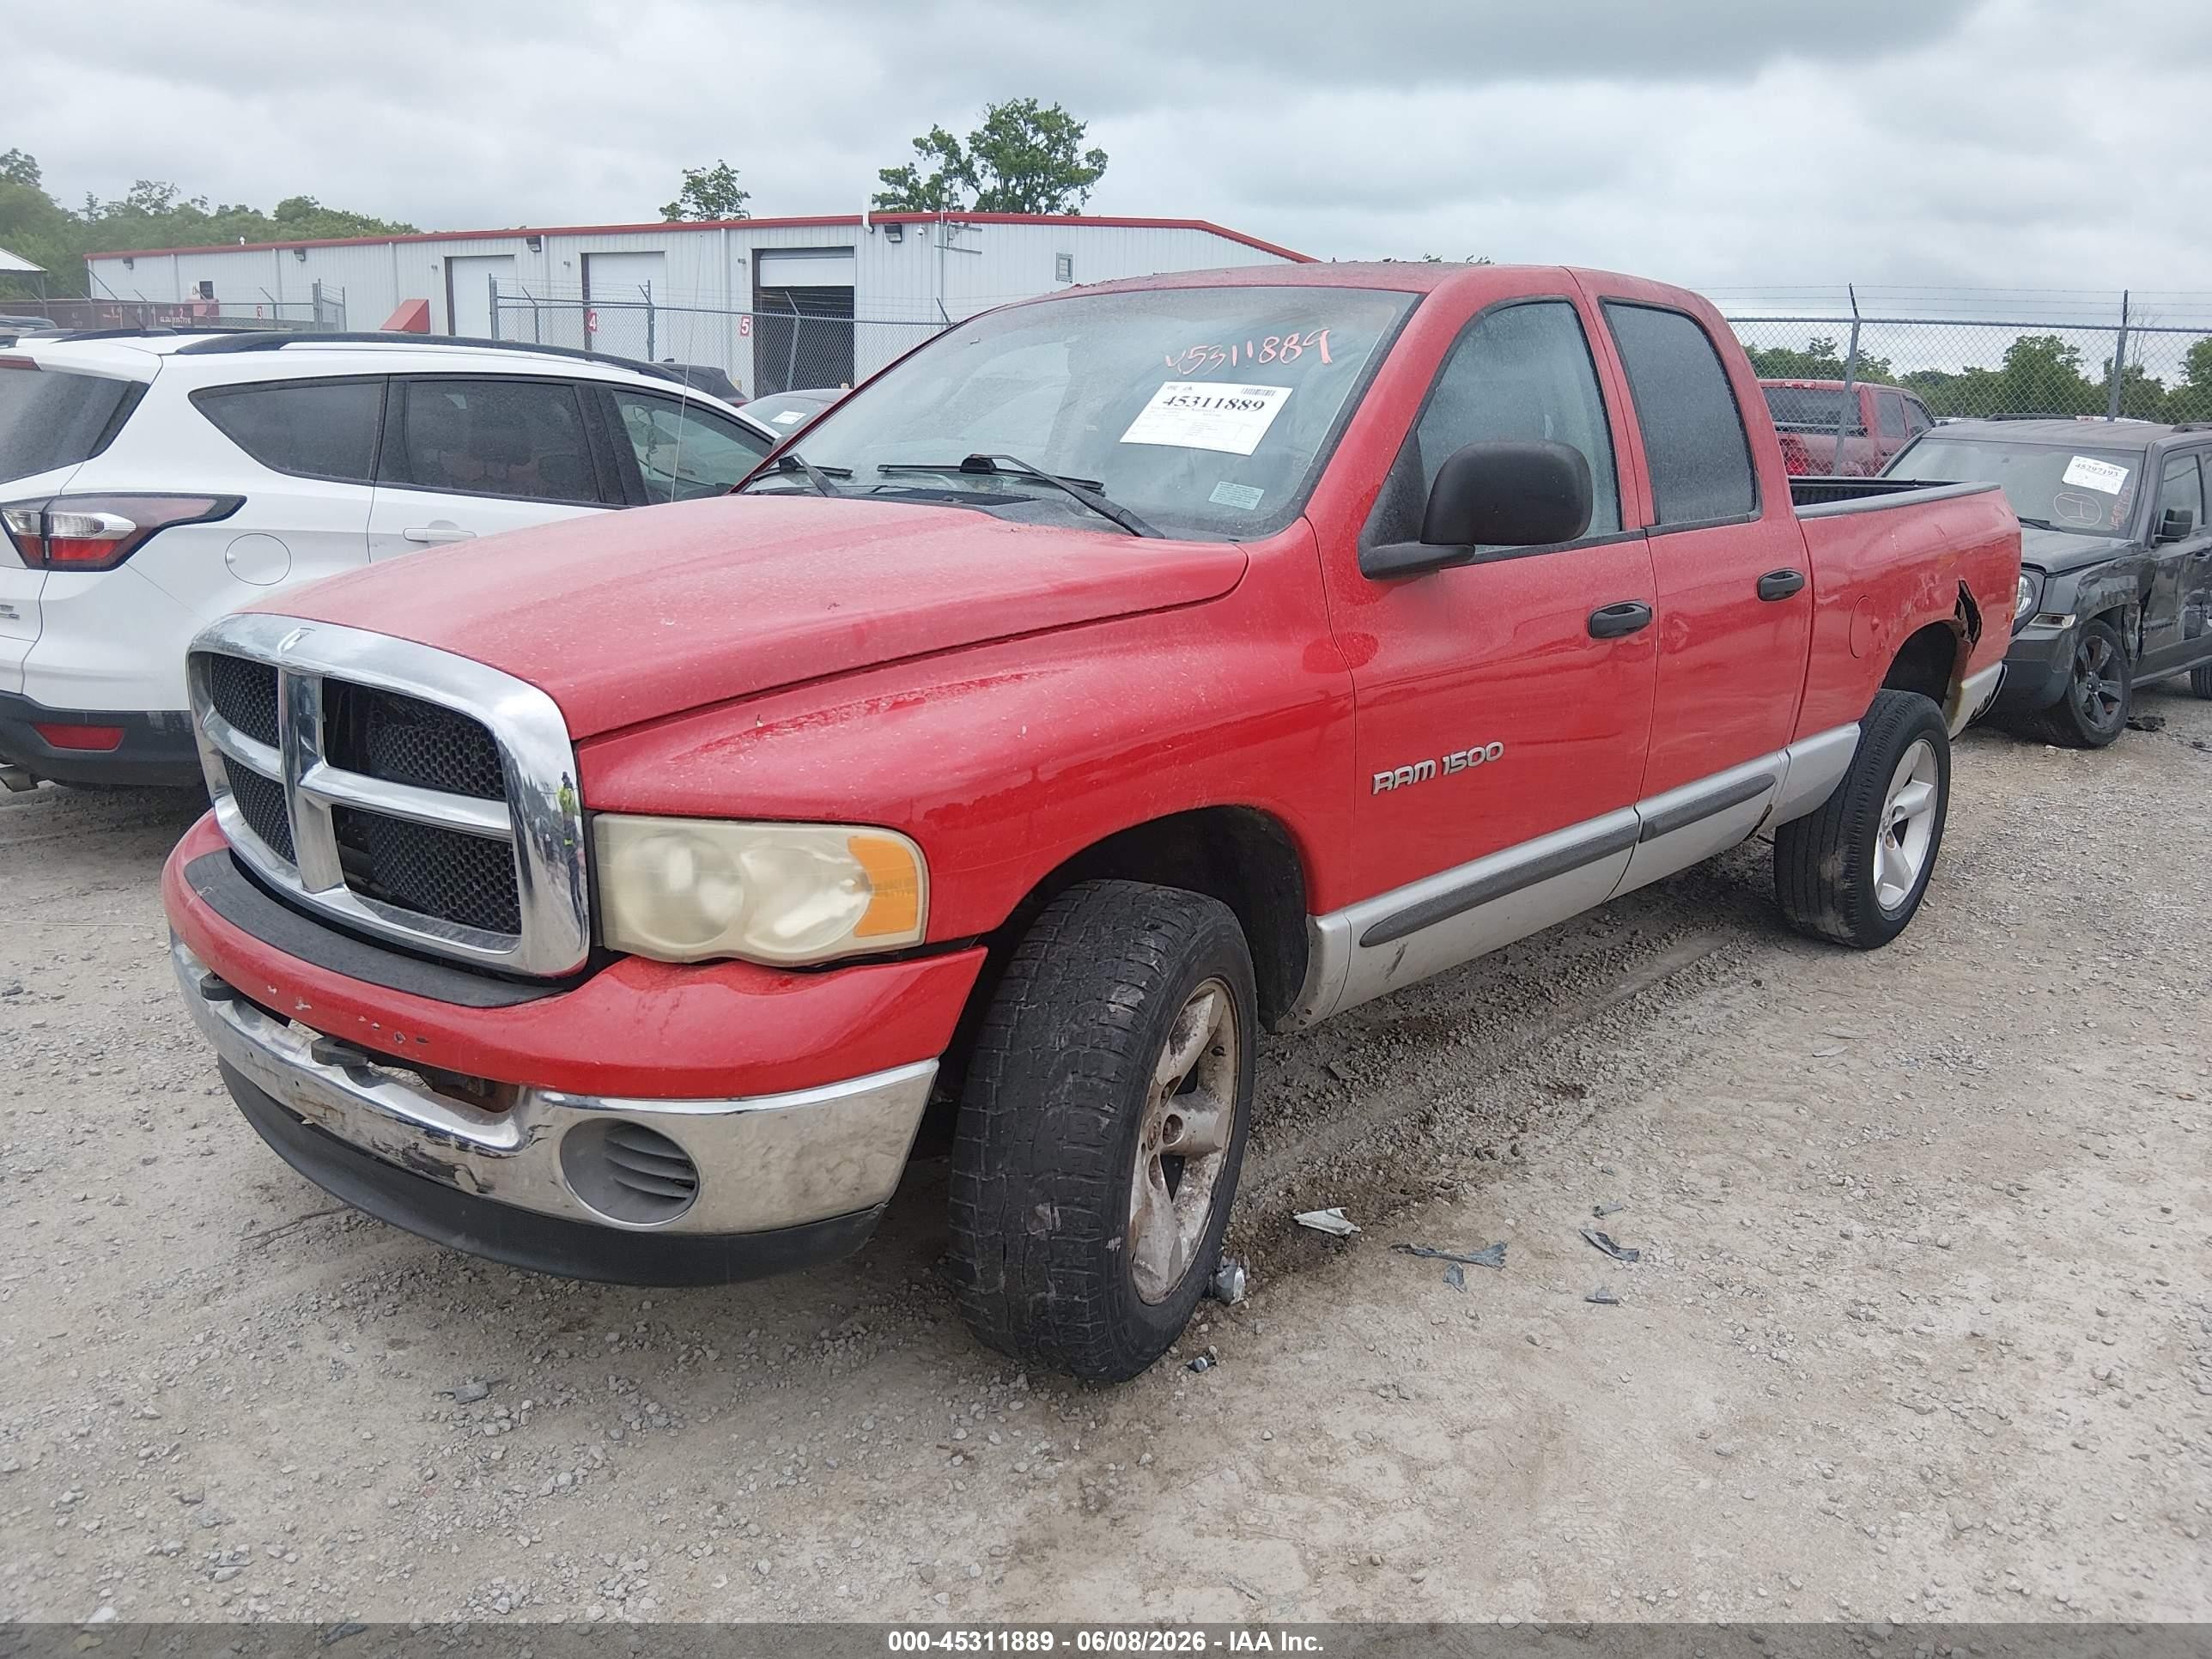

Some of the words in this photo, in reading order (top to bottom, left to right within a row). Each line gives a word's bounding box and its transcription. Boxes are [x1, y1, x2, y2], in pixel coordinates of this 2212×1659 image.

[257, 307, 264, 319] 3
[589, 314, 597, 330] 4
[741, 317, 750, 335] 5
[1164, 327, 1332, 376] 45311889
[1163, 395, 1265, 412] 45311889
[1371, 759, 1437, 795] RAM
[1441, 741, 1504, 776] 1500
